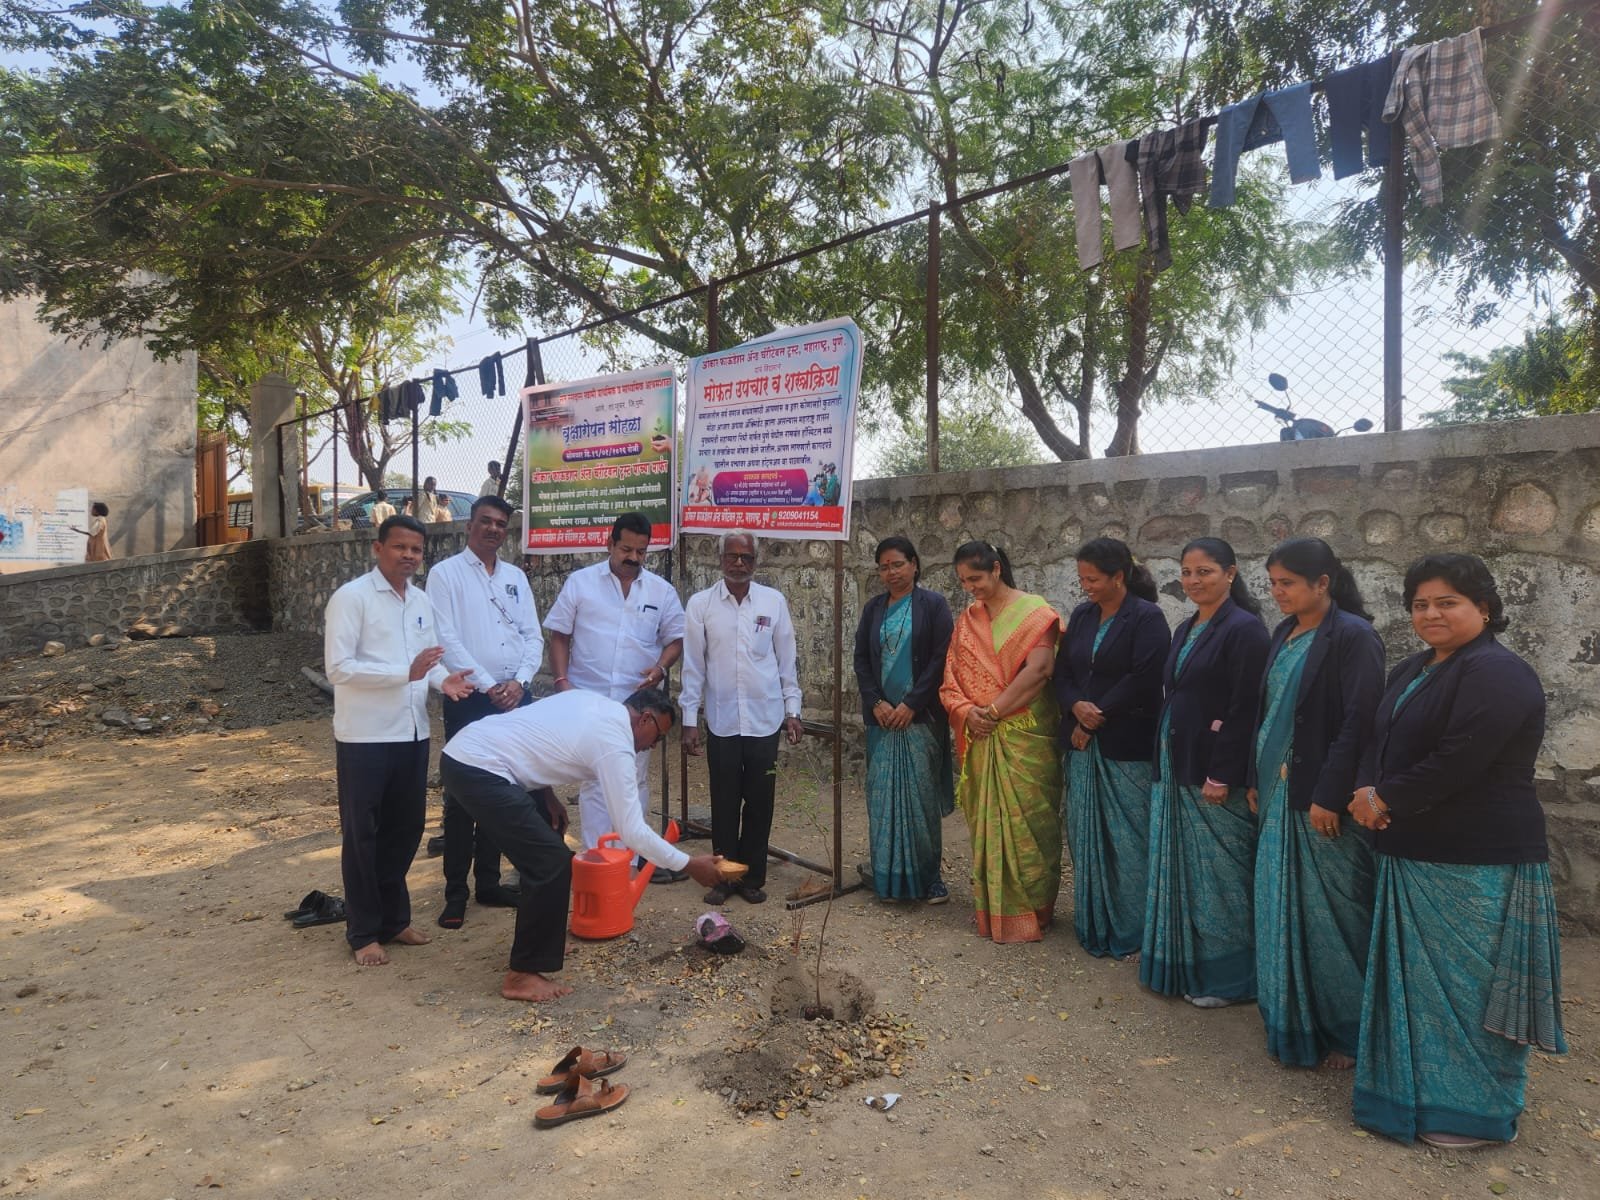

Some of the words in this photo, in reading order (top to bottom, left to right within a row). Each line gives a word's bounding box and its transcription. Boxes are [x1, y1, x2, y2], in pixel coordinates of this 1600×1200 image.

[704, 378, 733, 402] मोफत
[736, 375, 769, 398] उपचार
[772, 374, 781, 393] व
[785, 363, 840, 393] शस्त्रक्रिया
[608, 415, 641, 436] सोहळा
[778, 511, 819, 522] 9209041154
